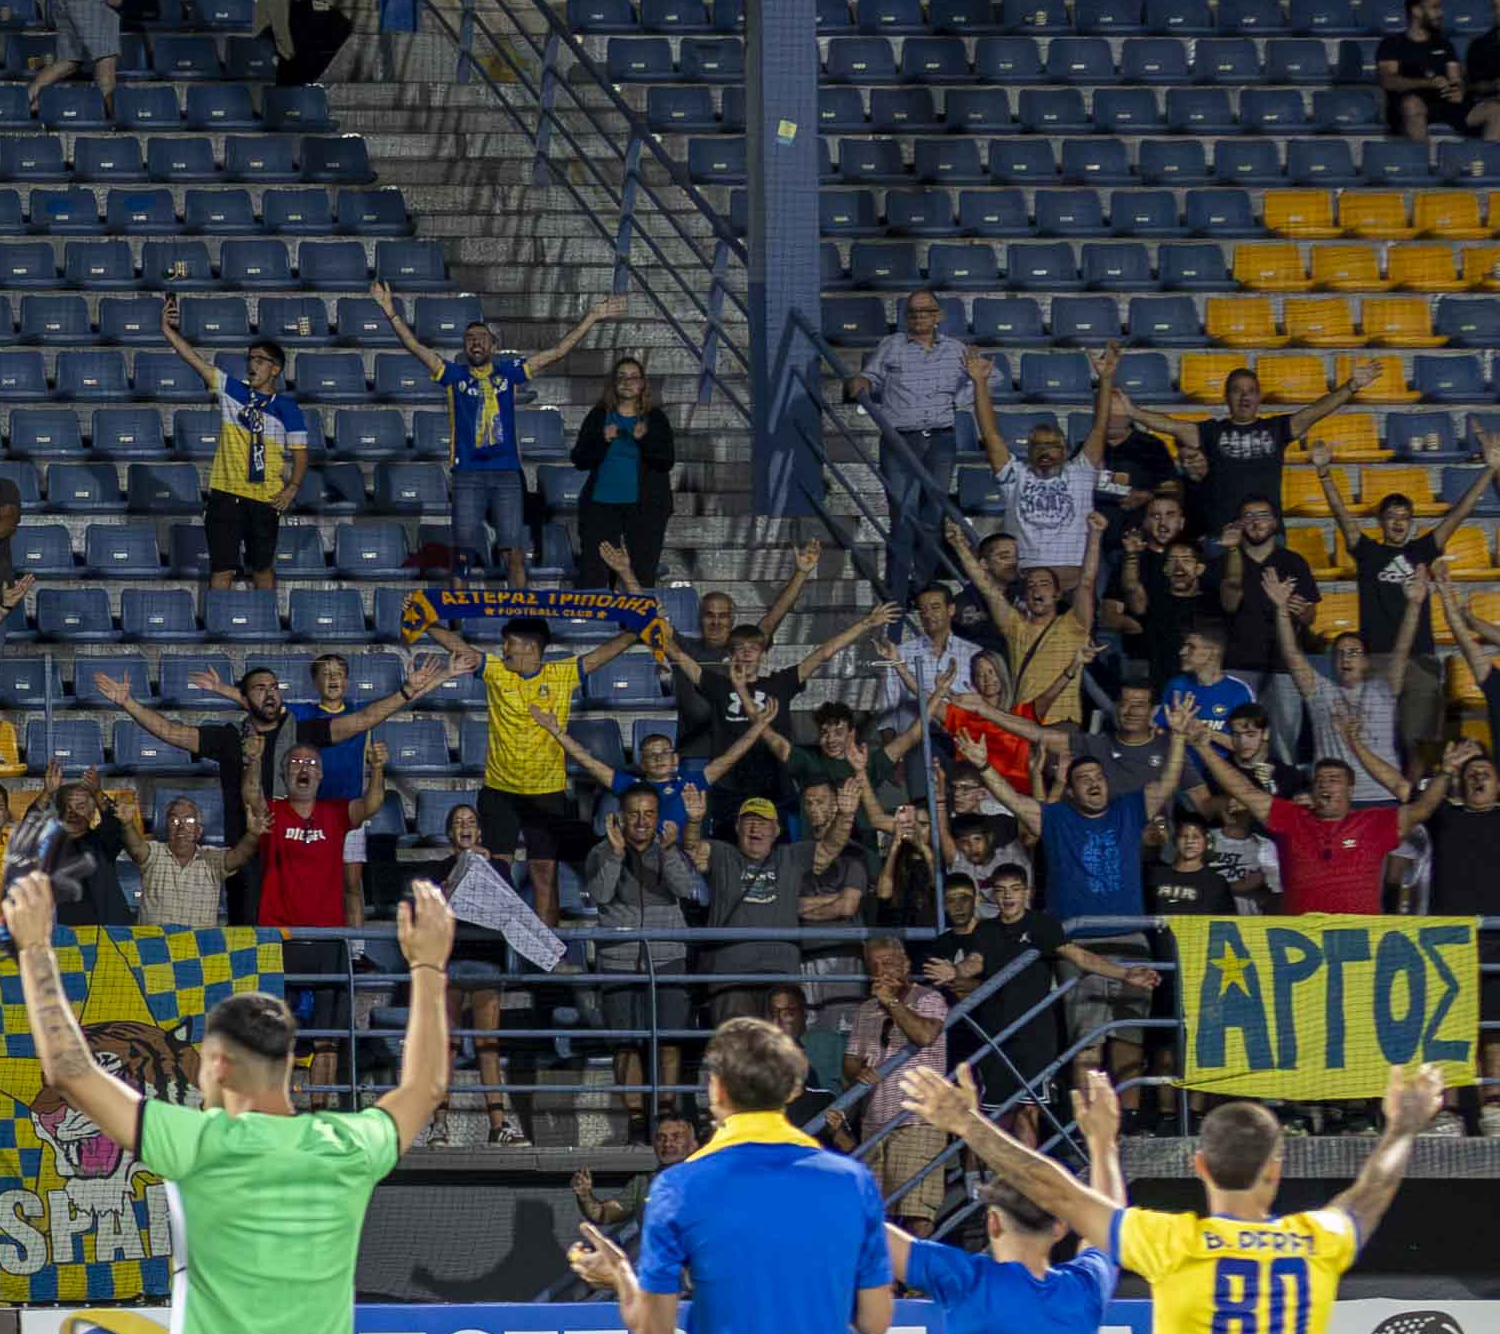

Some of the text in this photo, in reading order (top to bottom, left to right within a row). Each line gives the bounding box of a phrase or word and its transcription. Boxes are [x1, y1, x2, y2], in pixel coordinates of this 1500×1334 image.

[441, 589, 657, 617] ΑΣΤΕΡΑΣ ΤΡΙΠΟΛΗΣ
[498, 607, 594, 618] FOOTBALL CLUB
[1197, 920, 1472, 1071] ΑΡΓΟΣ
